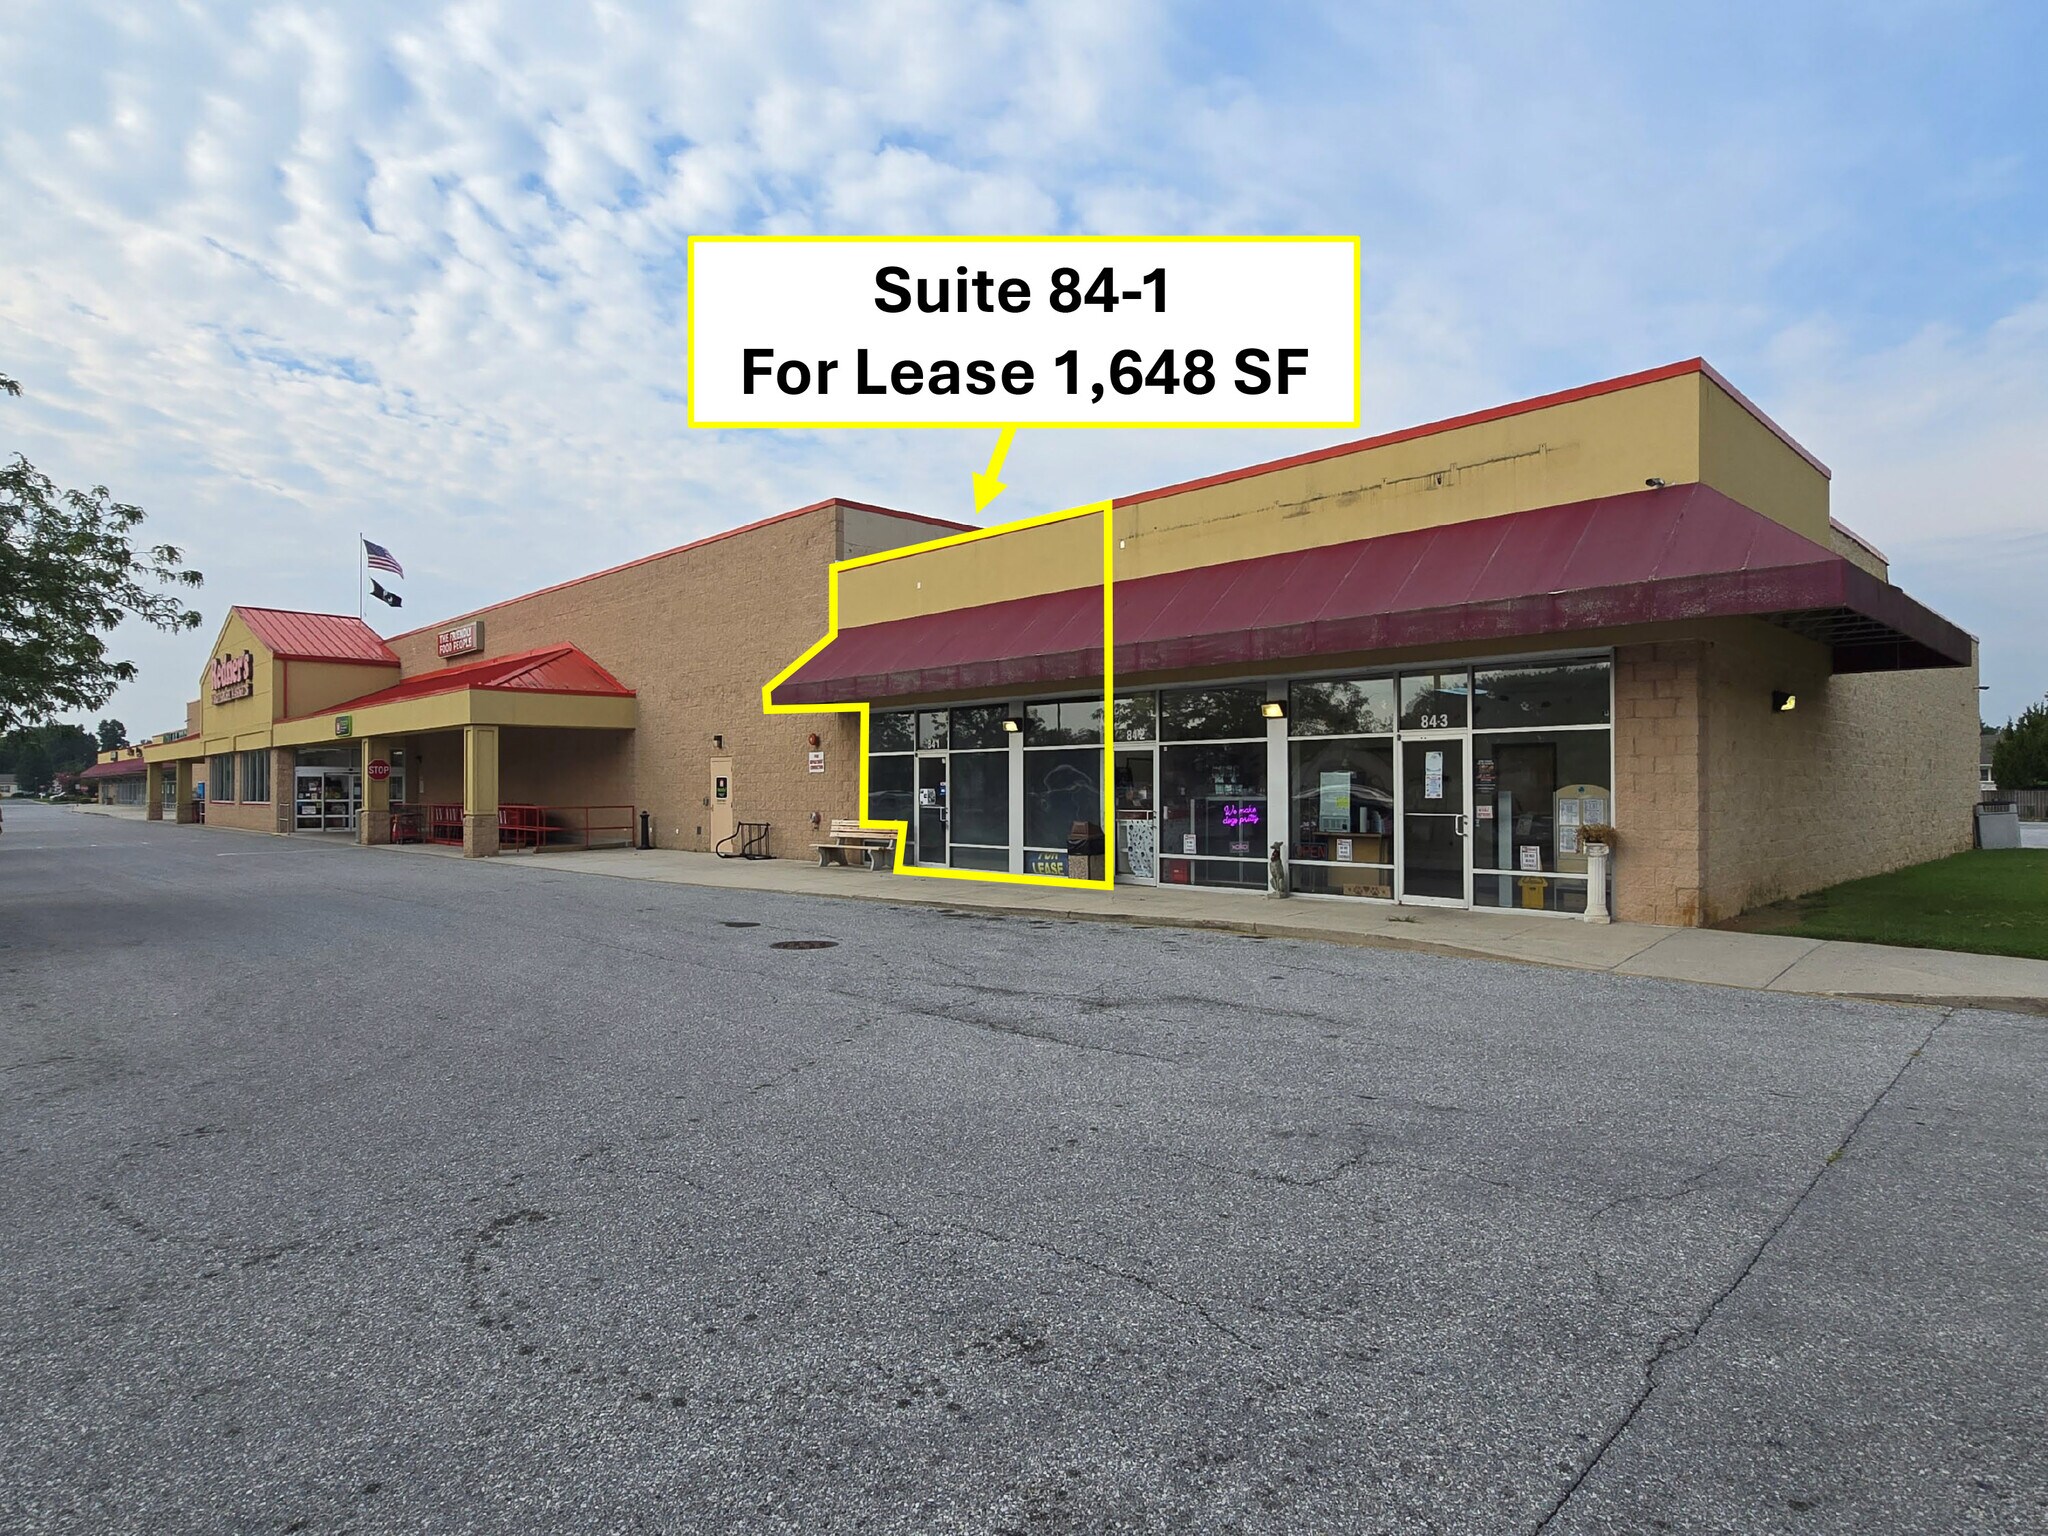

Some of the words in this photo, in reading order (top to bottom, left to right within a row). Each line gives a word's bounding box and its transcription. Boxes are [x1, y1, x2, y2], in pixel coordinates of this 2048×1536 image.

[439, 633, 450, 644] THE
[450, 627, 472, 641] FRIENDLY
[439, 642, 452, 655] FOOD
[453, 637, 472, 651] PEOPLE
[1420, 713, 1449, 729] 84-3
[368, 765, 389, 775] STOP
[1295, 844, 1326, 858] OPEN
[1032, 861, 1065, 875] LEASE
